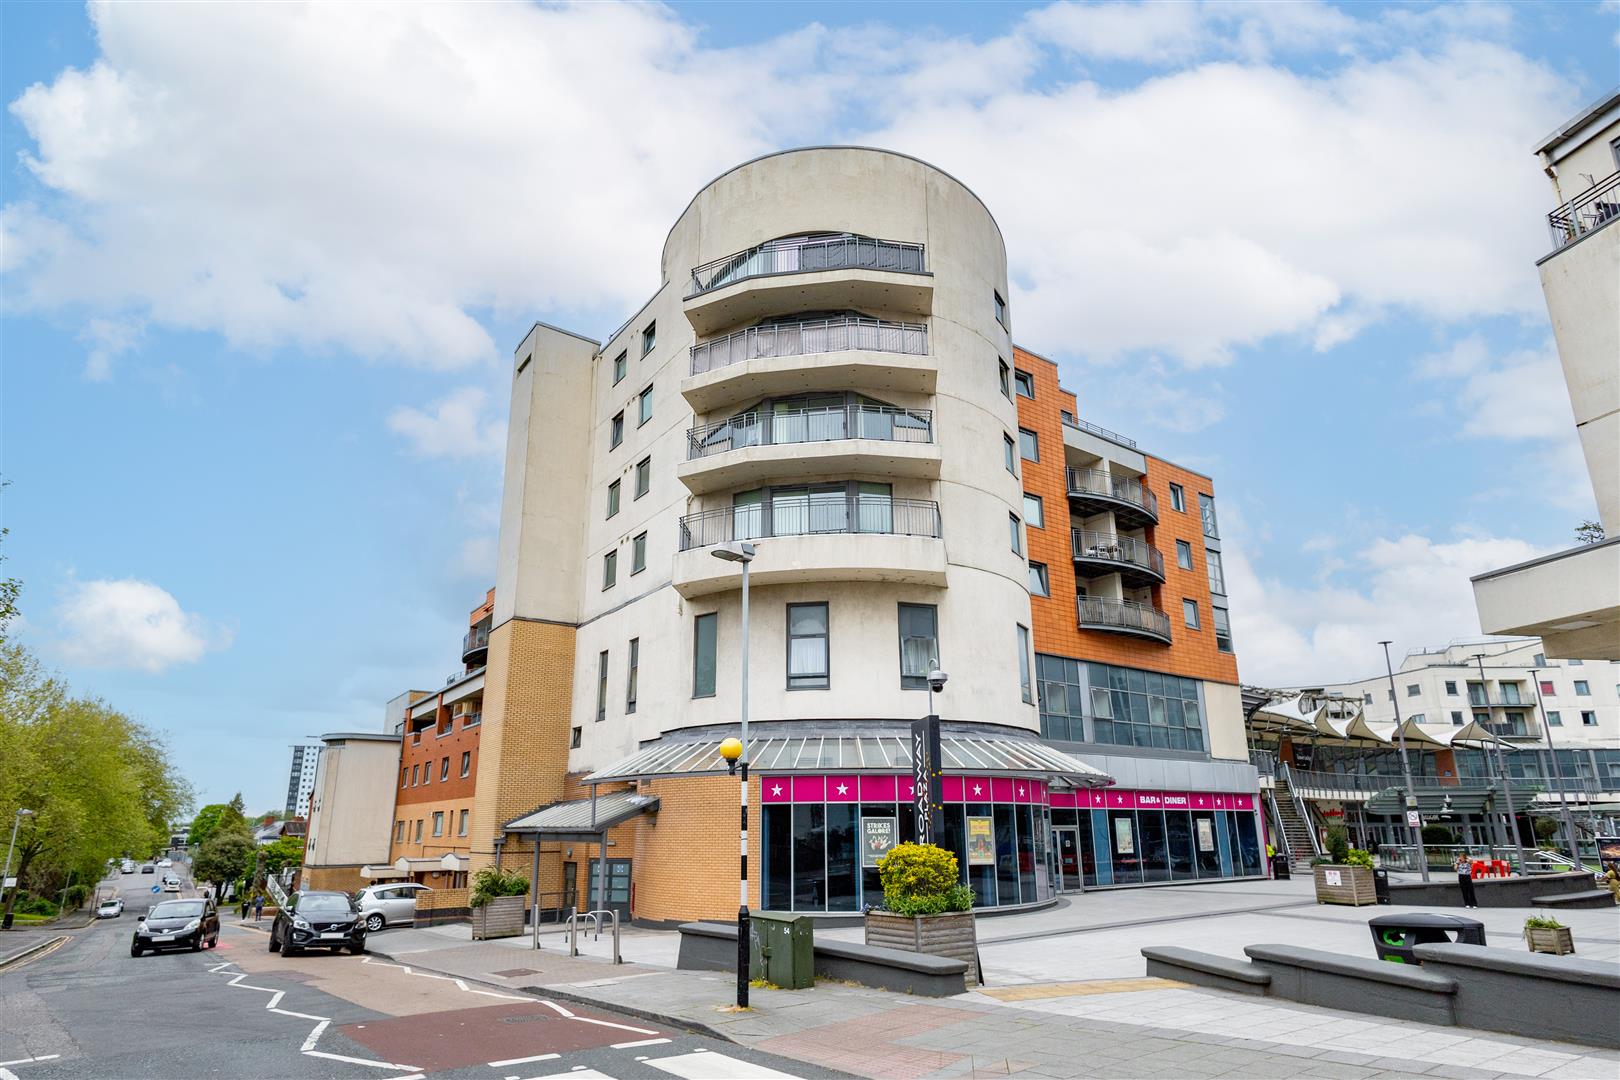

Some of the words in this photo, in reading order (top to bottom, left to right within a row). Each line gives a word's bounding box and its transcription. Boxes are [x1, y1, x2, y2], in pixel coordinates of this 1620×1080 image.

[915, 733, 925, 845] ROADWAY
[1140, 795, 1156, 804] BAR
[1164, 796, 1187, 805] DINER
